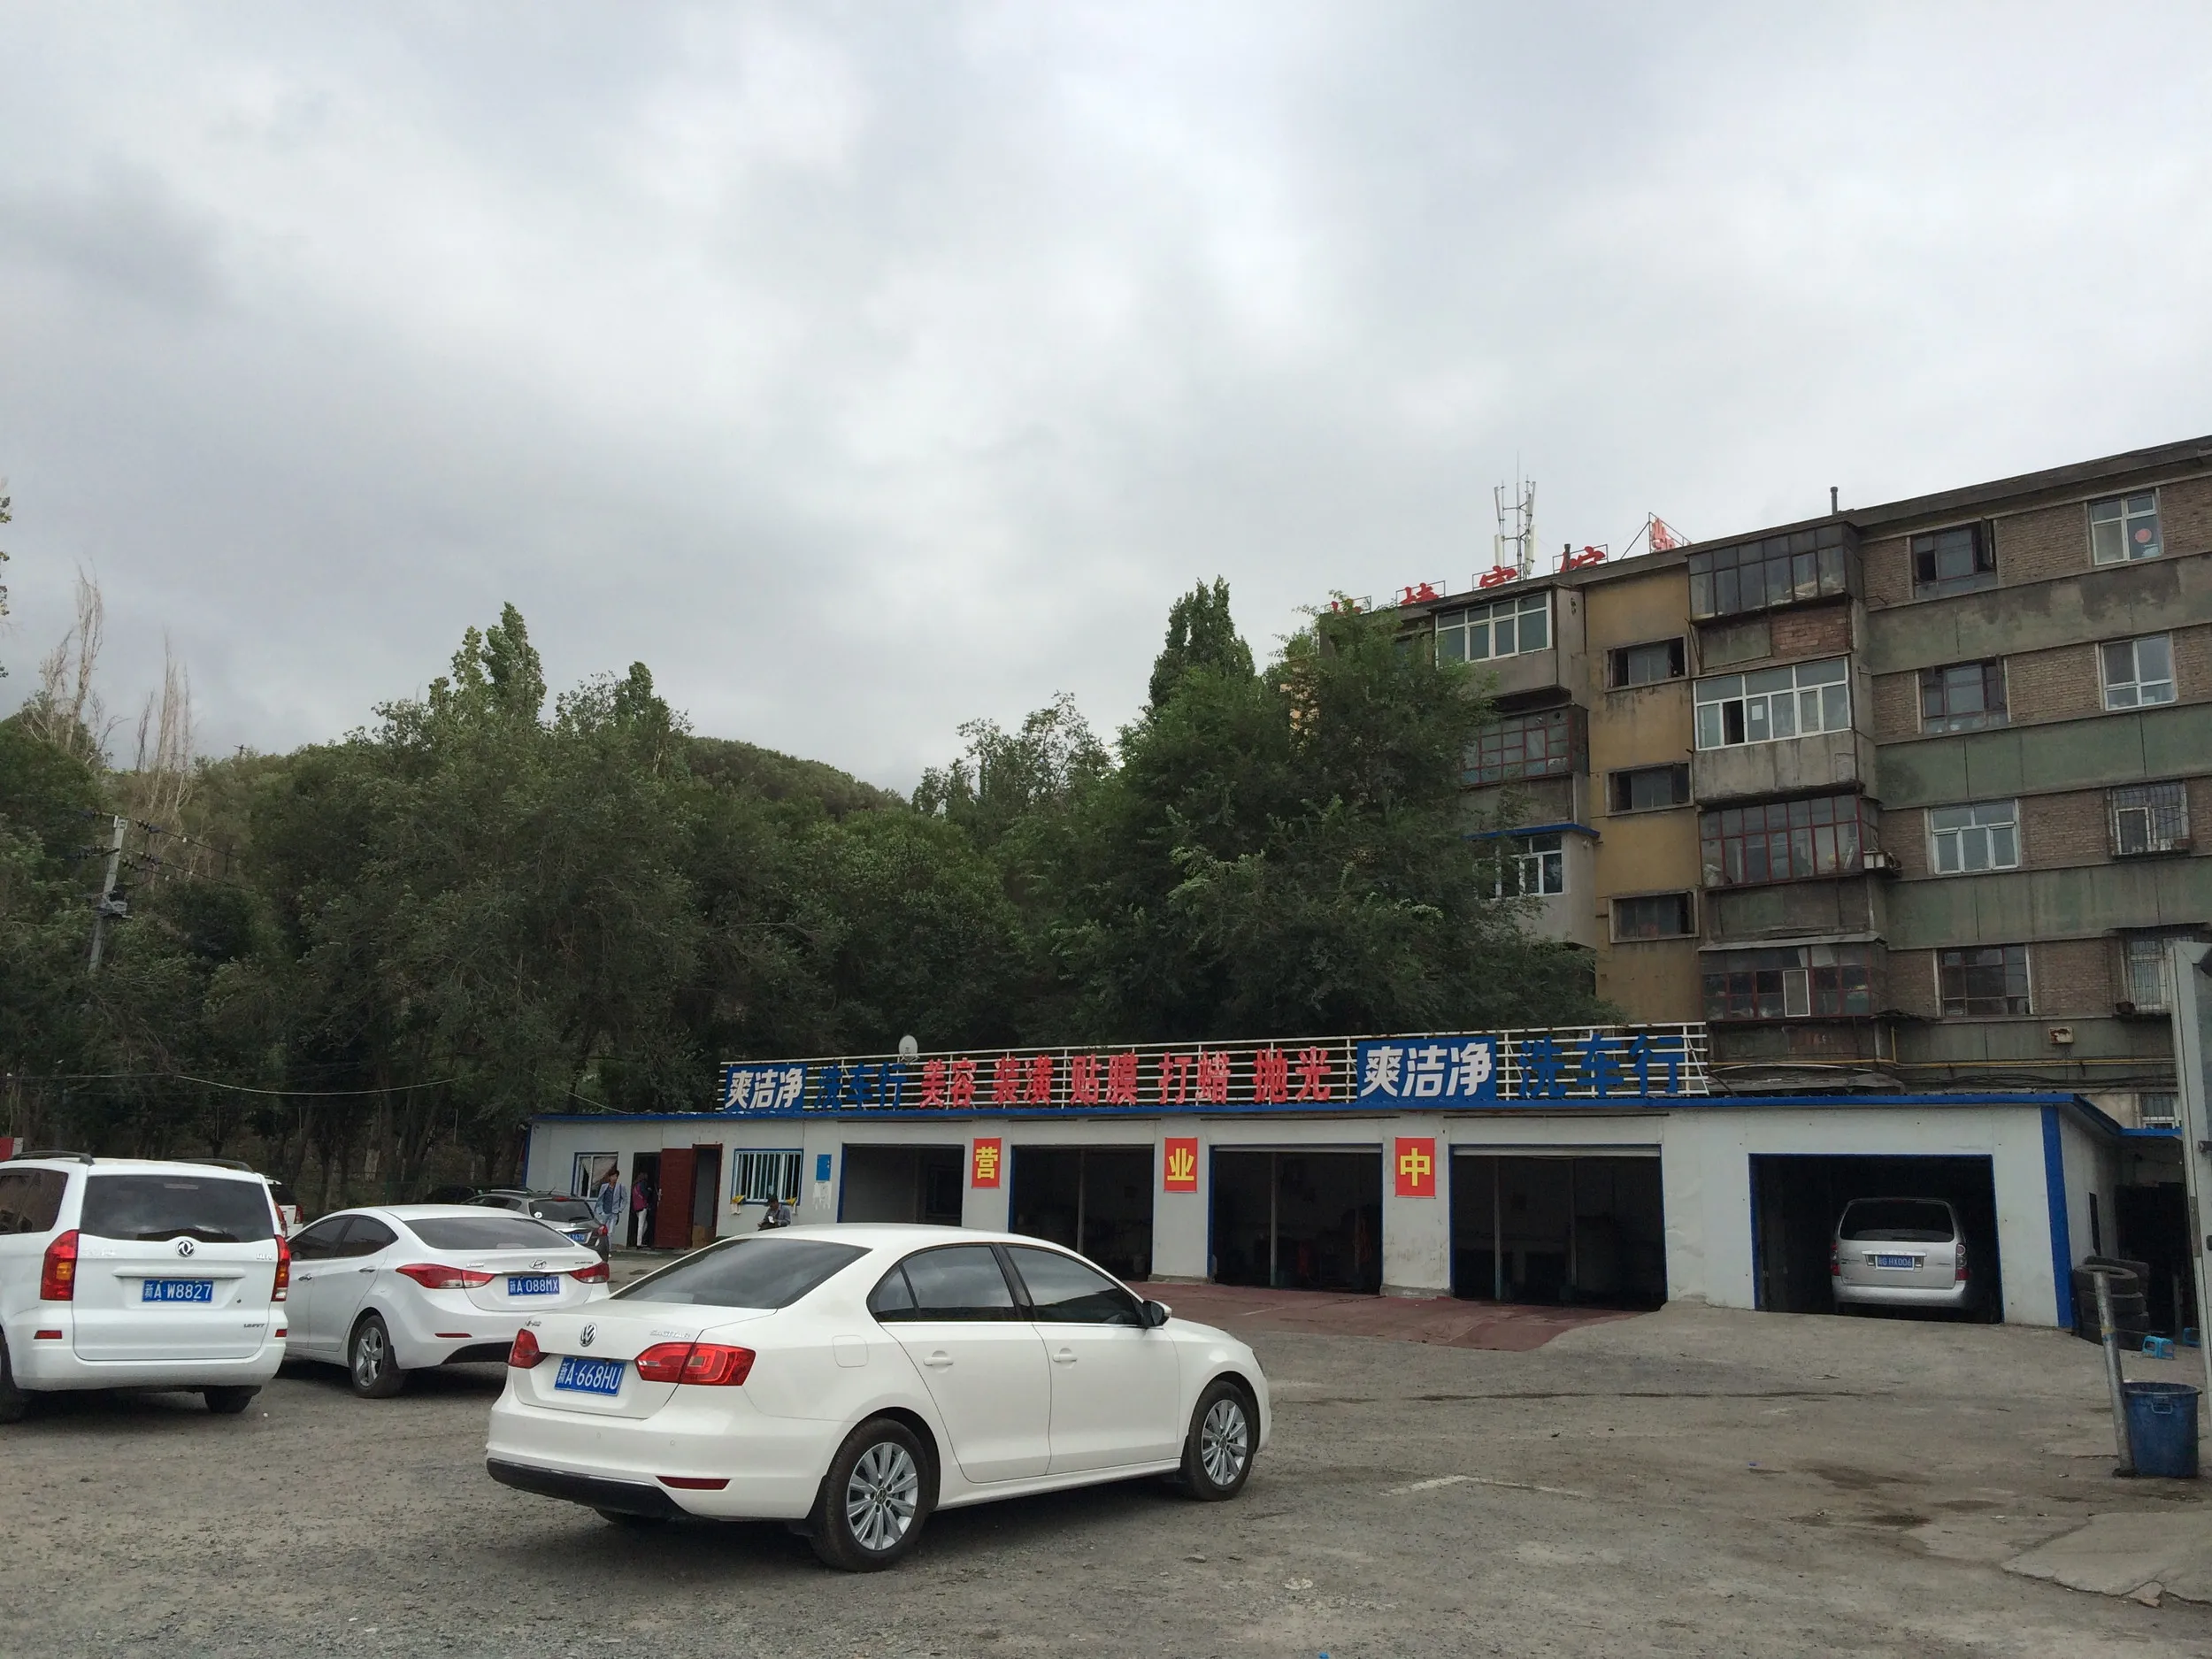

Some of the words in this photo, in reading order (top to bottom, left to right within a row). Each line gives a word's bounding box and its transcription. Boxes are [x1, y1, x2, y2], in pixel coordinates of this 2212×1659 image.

[817, 1061, 907, 1111] 洗车行
[920, 1057, 977, 1108] 美容
[993, 1055, 1054, 1107] 装潢
[1070, 1053, 1139, 1105] 贴膜
[1158, 1051, 1230, 1105] 打蜡
[1252, 1046, 1332, 1103] 抛光
[1360, 1042, 1492, 1097] 爽洁净
[1518, 1033, 1682, 1098] 洗车行
[725, 1068, 803, 1110] 爽洁净
[975, 1147, 998, 1179] 营
[1167, 1148, 1194, 1181] 业
[1400, 1148, 1431, 1187] 中
